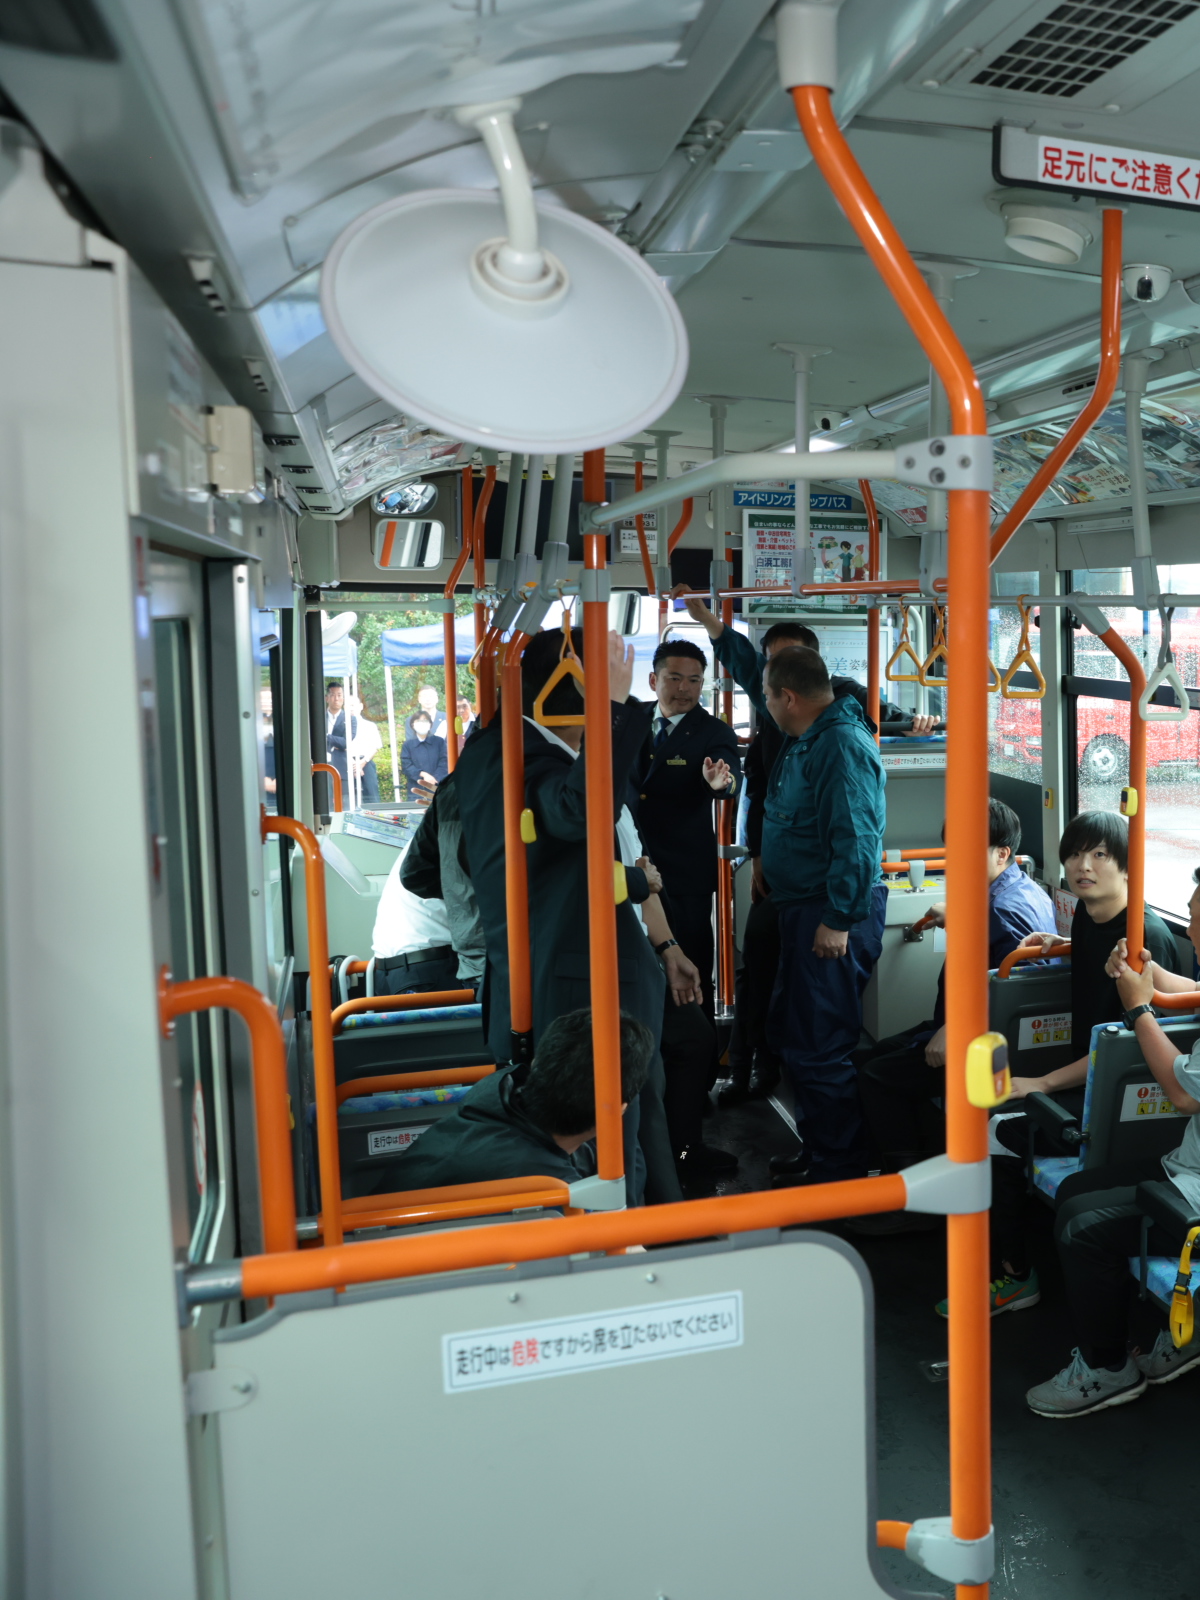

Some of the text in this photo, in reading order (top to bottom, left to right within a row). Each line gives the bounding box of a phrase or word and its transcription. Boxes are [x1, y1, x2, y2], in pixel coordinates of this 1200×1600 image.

[738, 493, 847, 508] アイドリングップバス
[374, 1132, 422, 1149] 走行中は危険で
[455, 1312, 733, 1377] 走行中は危険ですから席を立たないでください
